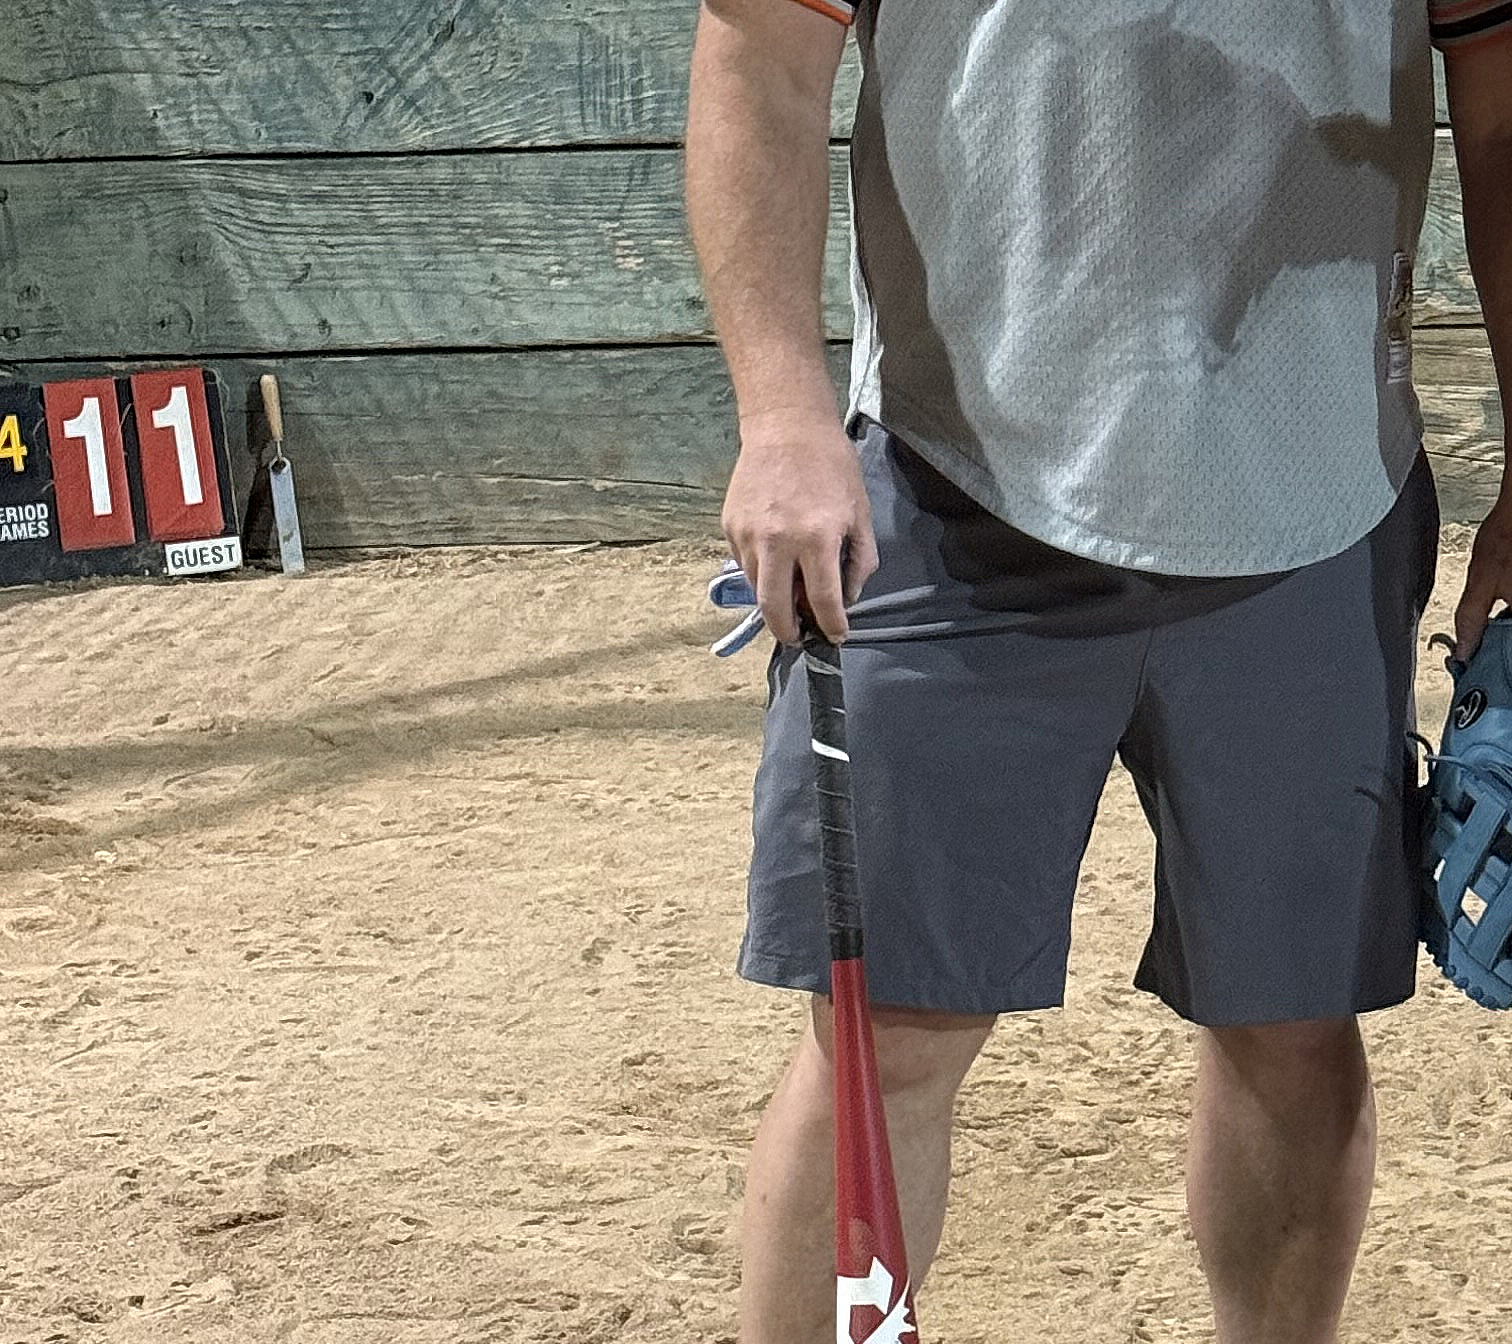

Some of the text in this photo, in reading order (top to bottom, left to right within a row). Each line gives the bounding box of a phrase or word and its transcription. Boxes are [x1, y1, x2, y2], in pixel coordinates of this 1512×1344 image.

[0, 414, 28, 473] 4
[0, 503, 49, 524] ERIOD
[0, 520, 50, 542] AMES
[170, 543, 236, 569] GUEST
